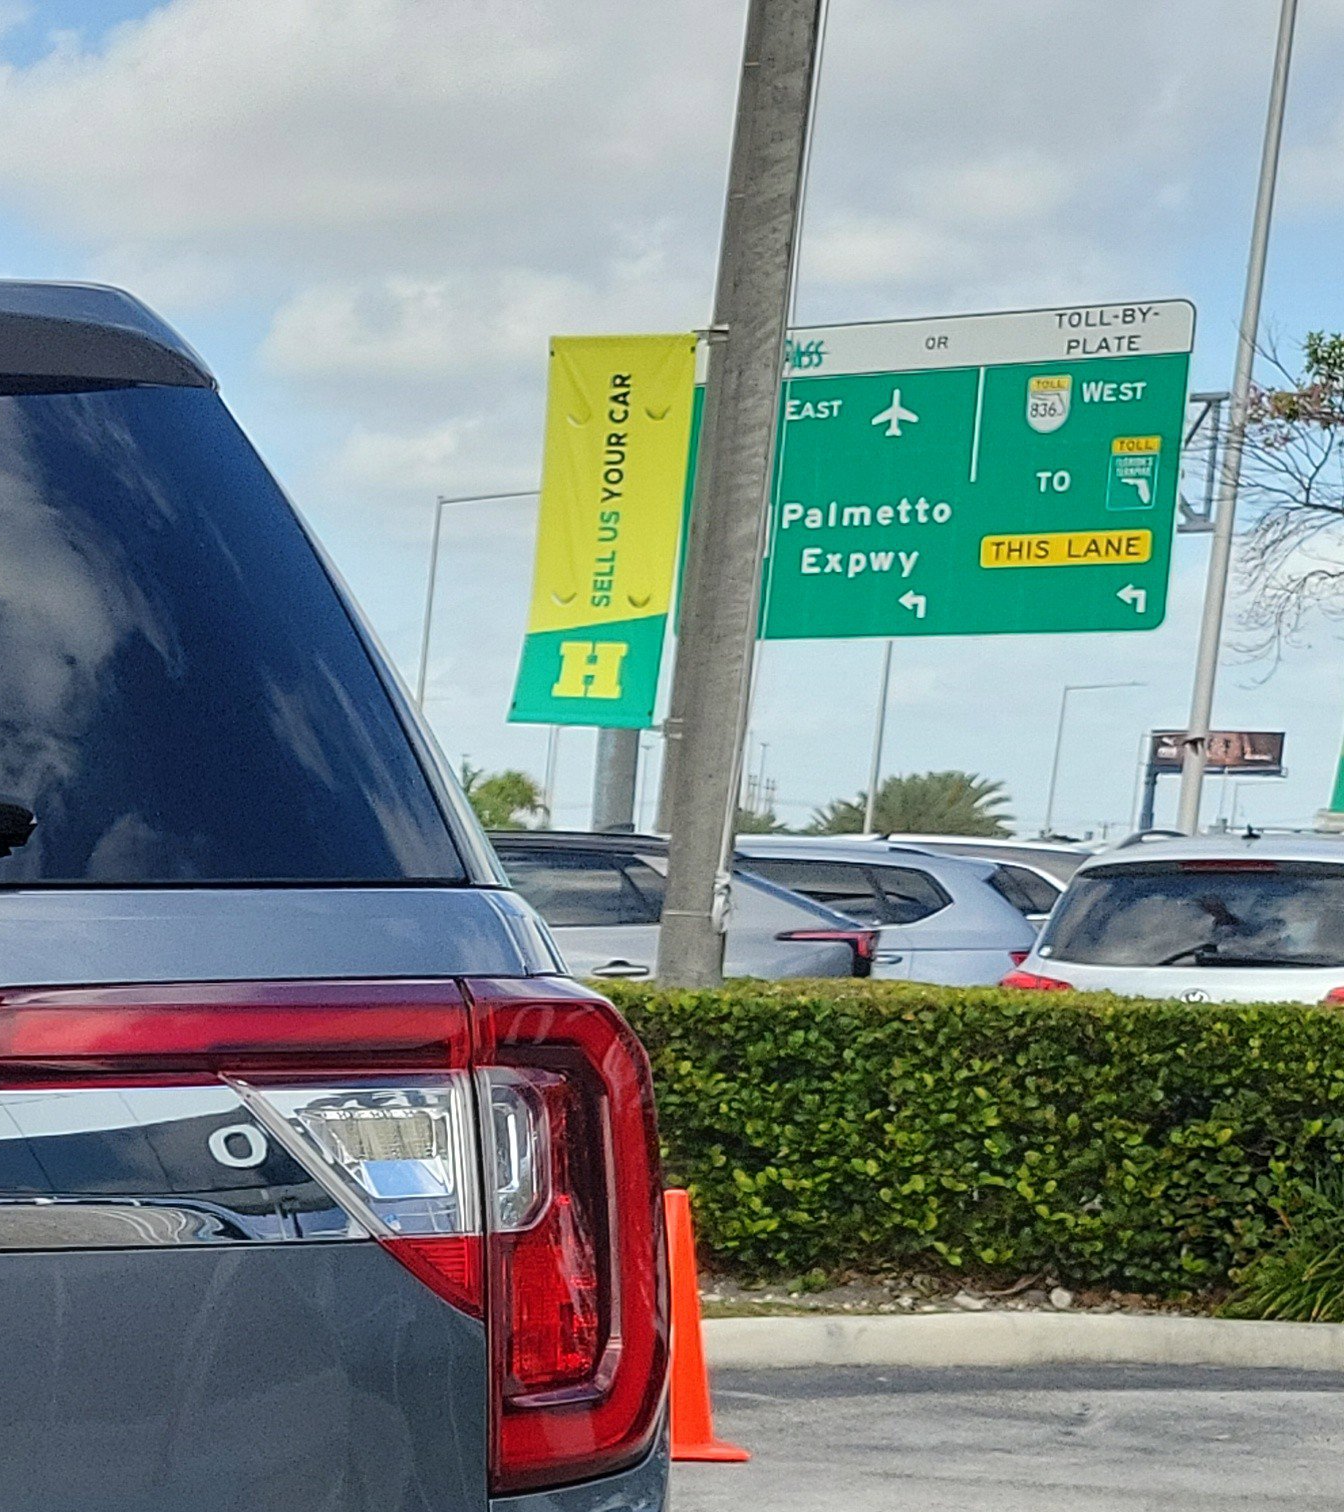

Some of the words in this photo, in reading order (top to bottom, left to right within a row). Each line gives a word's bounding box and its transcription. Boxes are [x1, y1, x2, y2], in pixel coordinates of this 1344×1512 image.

[1055, 306, 1160, 329] TOLL-BY-
[924, 336, 949, 350] OR
[1066, 335, 1141, 355] PLATE
[1036, 379, 1066, 389] TOLL
[1082, 381, 1147, 403] WEST
[608, 373, 632, 424] CAR
[785, 399, 843, 420] EAST
[1029, 401, 1058, 418] 836
[1119, 439, 1154, 452] TOLL
[601, 432, 629, 502] YOUR
[1036, 470, 1071, 492] TO
[781, 497, 952, 529] Palmetto
[598, 510, 621, 543] US
[991, 540, 1050, 561] THIS
[1067, 536, 1141, 558] LANE
[801, 547, 919, 578] Expwy
[591, 550, 616, 608] SELL
[551, 641, 629, 699] H
